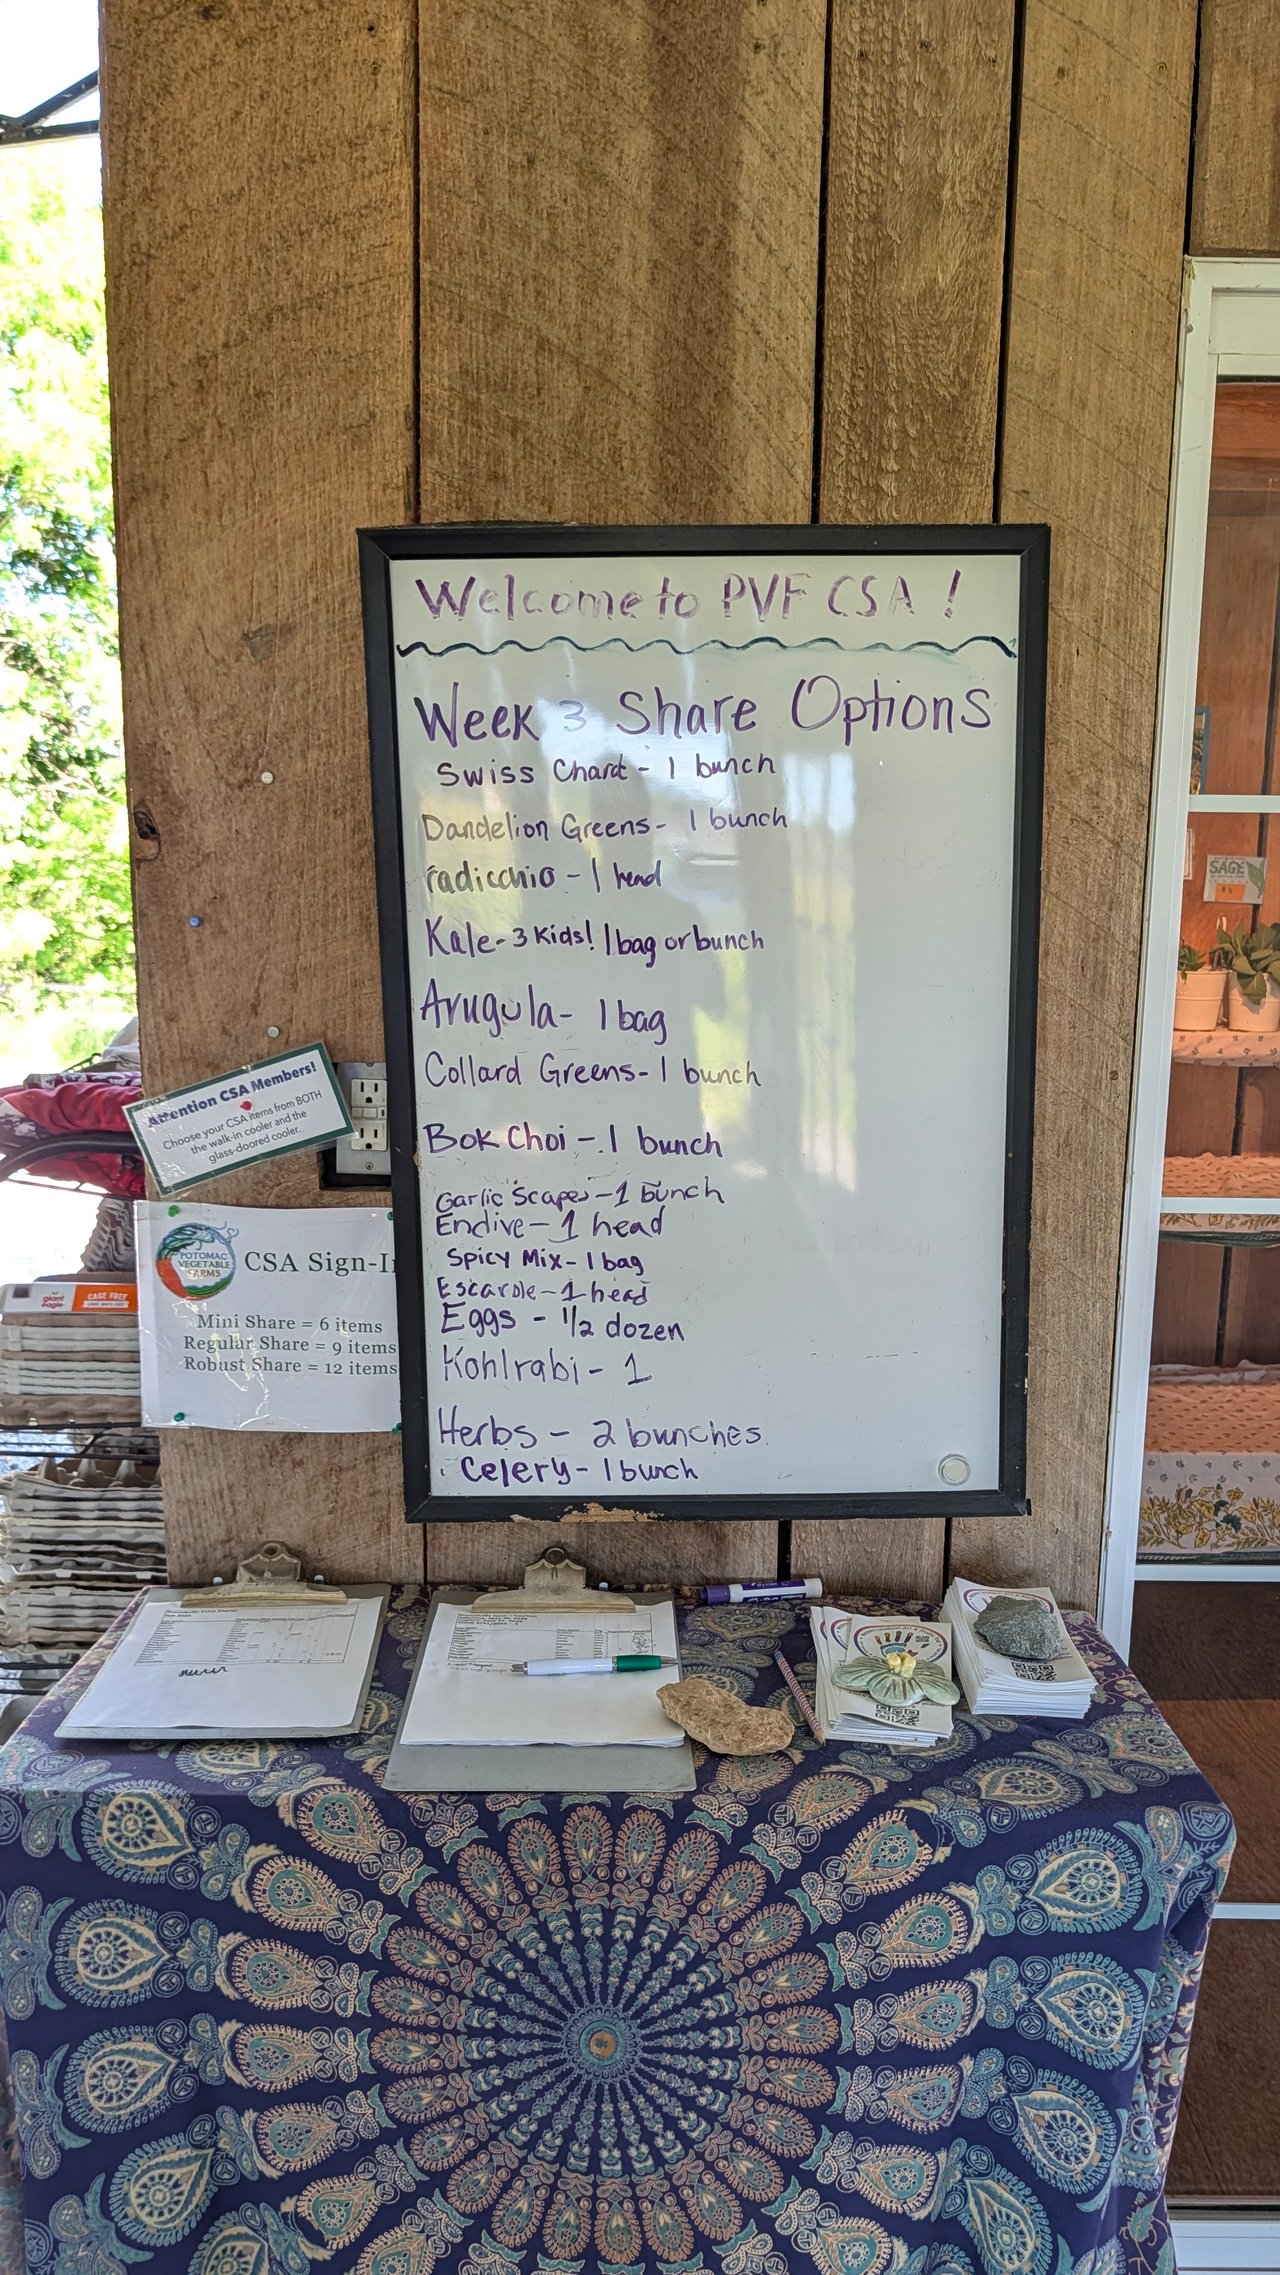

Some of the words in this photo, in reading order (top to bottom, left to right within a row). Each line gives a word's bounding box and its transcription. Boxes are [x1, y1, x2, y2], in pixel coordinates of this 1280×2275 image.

[416, 574, 642, 622] Welcome
[657, 575, 699, 620] to
[722, 572, 811, 622] PVF
[827, 575, 915, 622] CSA
[414, 683, 540, 750] Week
[561, 700, 586, 731] 3
[616, 686, 758, 740] Share
[790, 675, 991, 746] Options
[437, 759, 535, 788] Swiss
[696, 752, 775, 777] bunch
[421, 813, 549, 842] Dandelion
[710, 807, 788, 830] bunch
[1209, 860, 1245, 874] SAGE
[615, 928, 657, 968] bag
[664, 930, 691, 952] or
[692, 924, 765, 952] bunch
[618, 999, 667, 1045] bag
[425, 1051, 522, 1087] Collard
[683, 1059, 762, 1087] bunch
[148, 1096, 217, 1127] Attention
[219, 1083, 250, 1103] CSA
[250, 1061, 317, 1093] Members!
[163, 1131, 202, 1150] Choose
[203, 1123, 225, 1138] your
[226, 1115, 248, 1129] CSA
[249, 1107, 274, 1121] items
[274, 1101, 295, 1115] from
[296, 1090, 322, 1105] BOTH
[191, 1143, 208, 1155] the
[209, 1132, 243, 1151] walk-in
[244, 1124, 273, 1138] cooler
[275, 1115, 290, 1130] and
[290, 1109, 307, 1124] the
[208, 1134, 270, 1164] glass-doored
[423, 1122, 500, 1155] Bok
[507, 1121, 566, 1152] Choi
[638, 1125, 724, 1158] bunch
[436, 1188, 503, 1213] Garlic
[641, 1176, 725, 1204] bunch
[592, 1205, 665, 1238] head
[178, 1260, 231, 1269] VEGETABLE
[180, 1252, 228, 1260] POTOMAC
[244, 1251, 299, 1273] CSA
[308, 1252, 397, 1277] Sign-I
[447, 1248, 510, 1270] Spicy
[602, 1252, 644, 1276] bag
[87, 1292, 107, 1300] CAGE
[109, 1292, 128, 1301] FREE
[591, 1281, 648, 1306] head
[196, 1314, 239, 1329] Mini
[245, 1314, 296, 1330] Share
[319, 1317, 329, 1331] 6
[335, 1317, 383, 1334] items
[441, 1301, 516, 1338] Eggs
[605, 1312, 685, 1341] dozen
[183, 1335, 254, 1353] Regular
[260, 1336, 310, 1352] Share
[332, 1342, 342, 1356] 9
[348, 1339, 397, 1354] items
[184, 1356, 246, 1372] Robust
[252, 1357, 302, 1373] Share
[324, 1363, 343, 1374] 12
[349, 1361, 398, 1375] items
[624, 1353, 652, 1385] 1
[438, 1405, 538, 1448] Herbs
[592, 1420, 616, 1448] 2
[626, 1418, 761, 1448] bunches
[620, 1458, 699, 1481] bunch
